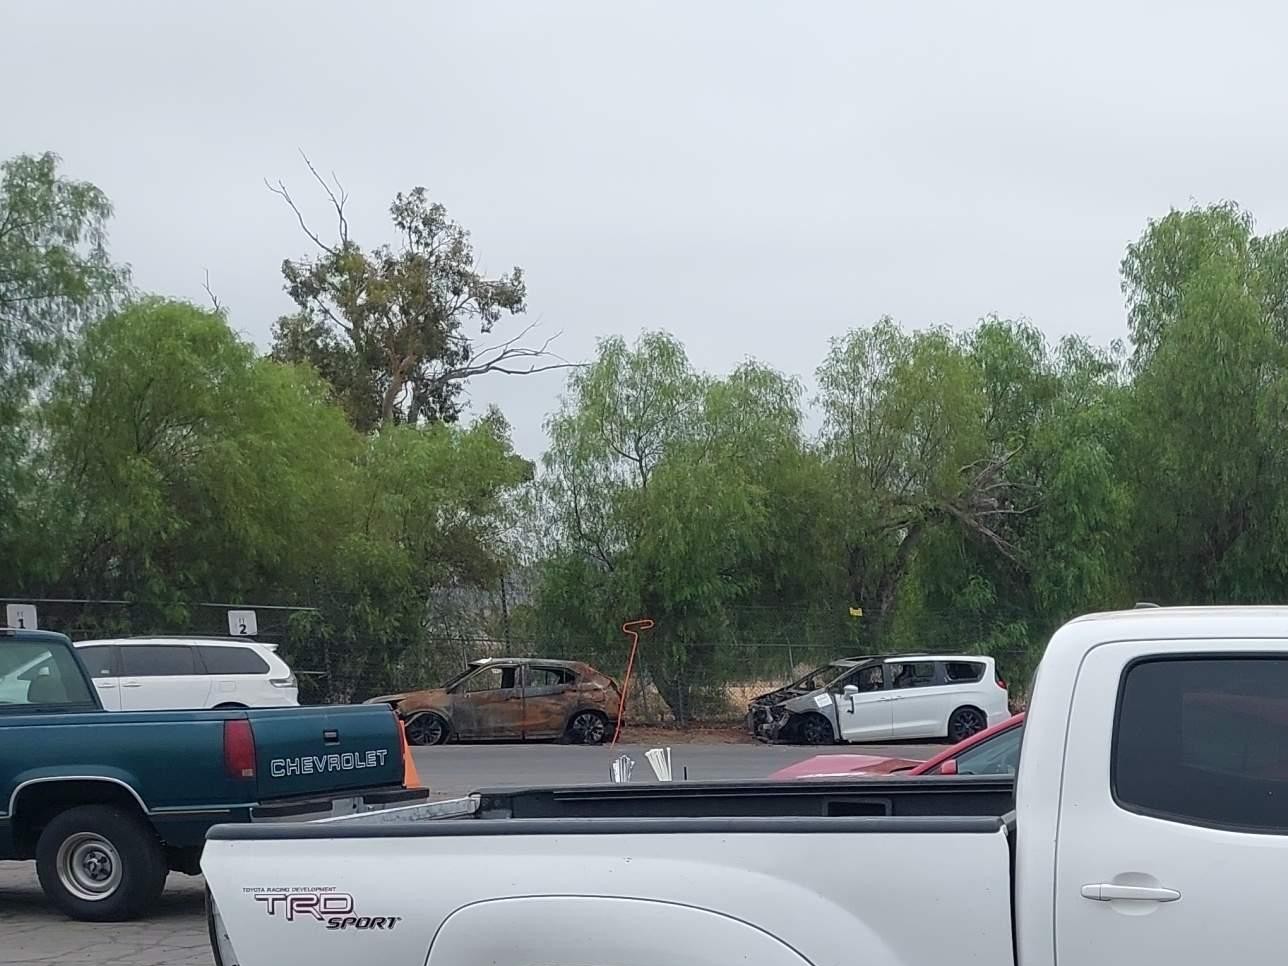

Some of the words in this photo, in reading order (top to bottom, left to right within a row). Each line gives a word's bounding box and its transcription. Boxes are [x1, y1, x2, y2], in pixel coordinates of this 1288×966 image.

[239, 624, 248, 635] 2
[270, 749, 388, 777] CHEVROLET
[254, 892, 355, 922] TRD
[326, 916, 398, 930] SPORT
